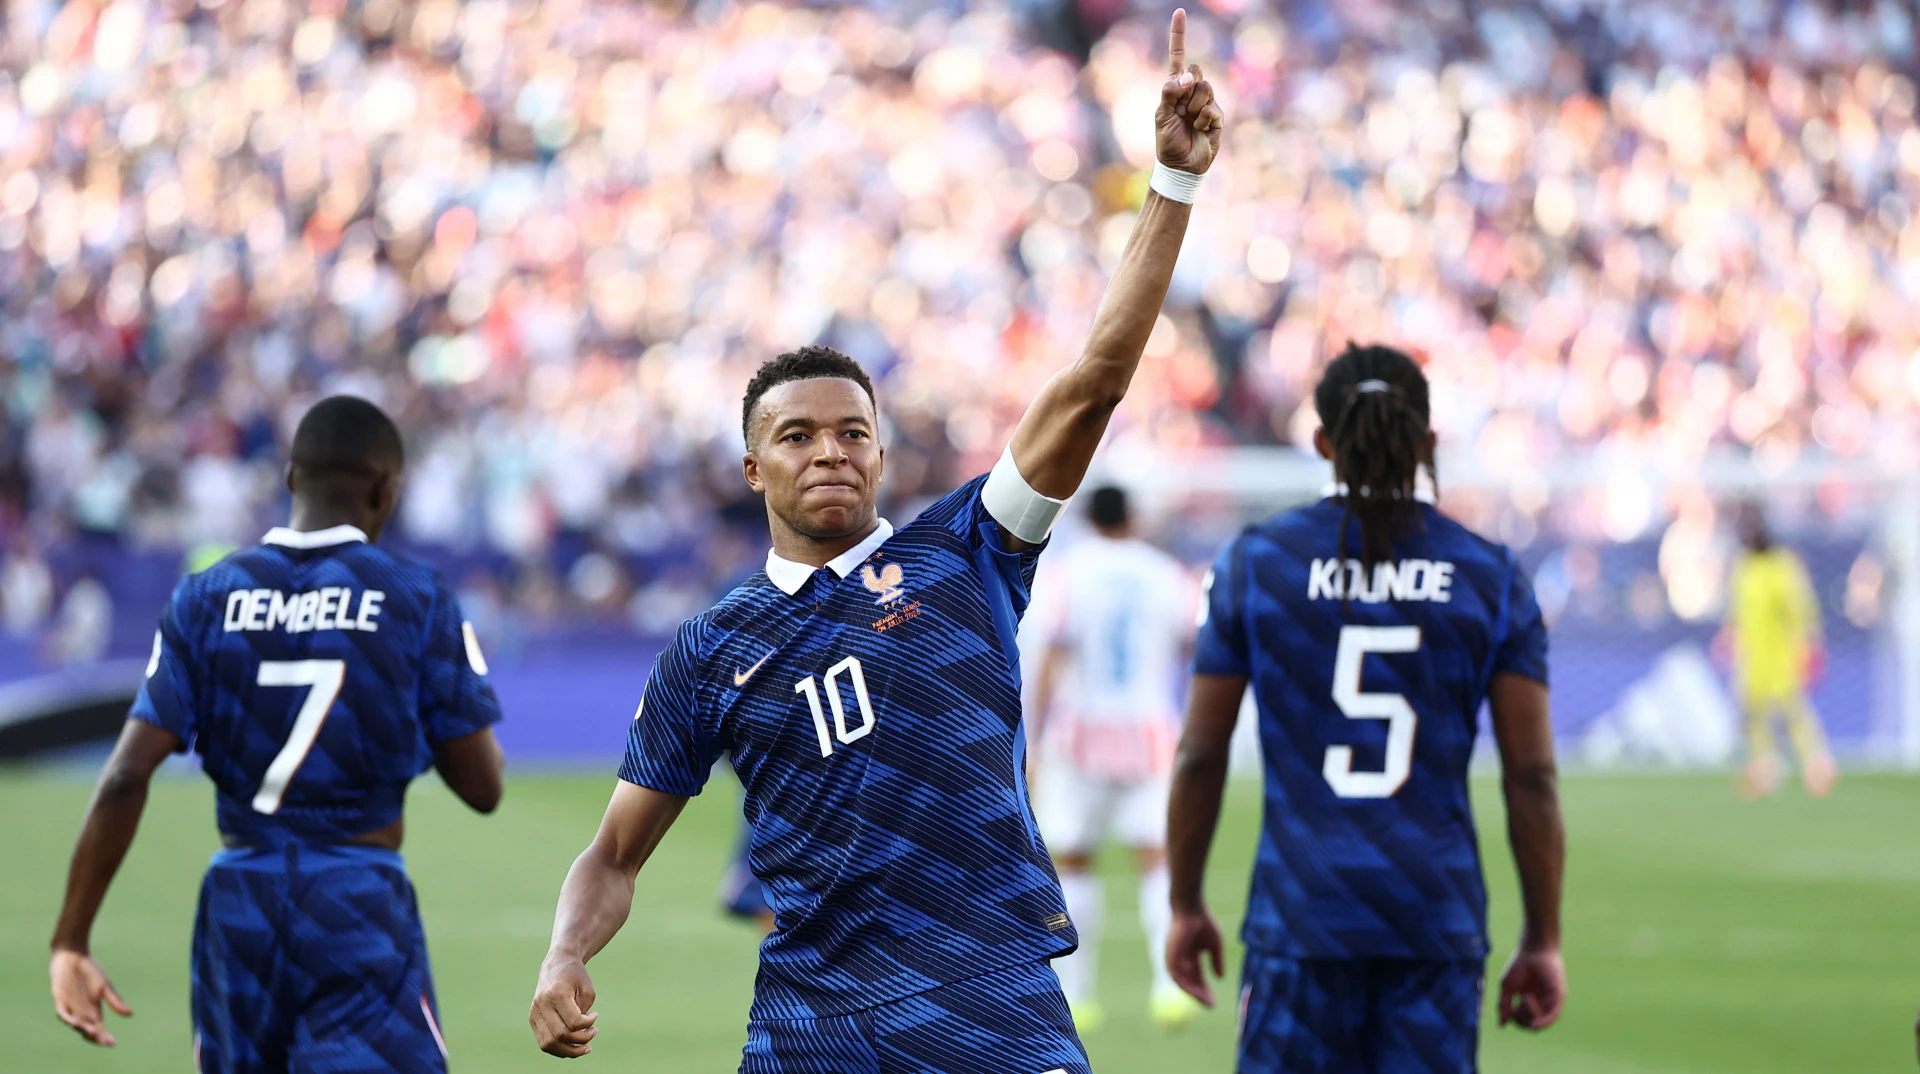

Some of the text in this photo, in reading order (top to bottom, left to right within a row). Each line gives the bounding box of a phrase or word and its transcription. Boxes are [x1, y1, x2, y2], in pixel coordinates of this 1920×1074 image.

[1307, 557, 1455, 603] KOUNDE
[223, 587, 386, 633] DEMBELE
[872, 611, 898, 629] PARAGUAY
[904, 609, 921, 620] 2026
[795, 655, 876, 758] 10
[1322, 624, 1422, 799] 5
[252, 659, 346, 815] 7
